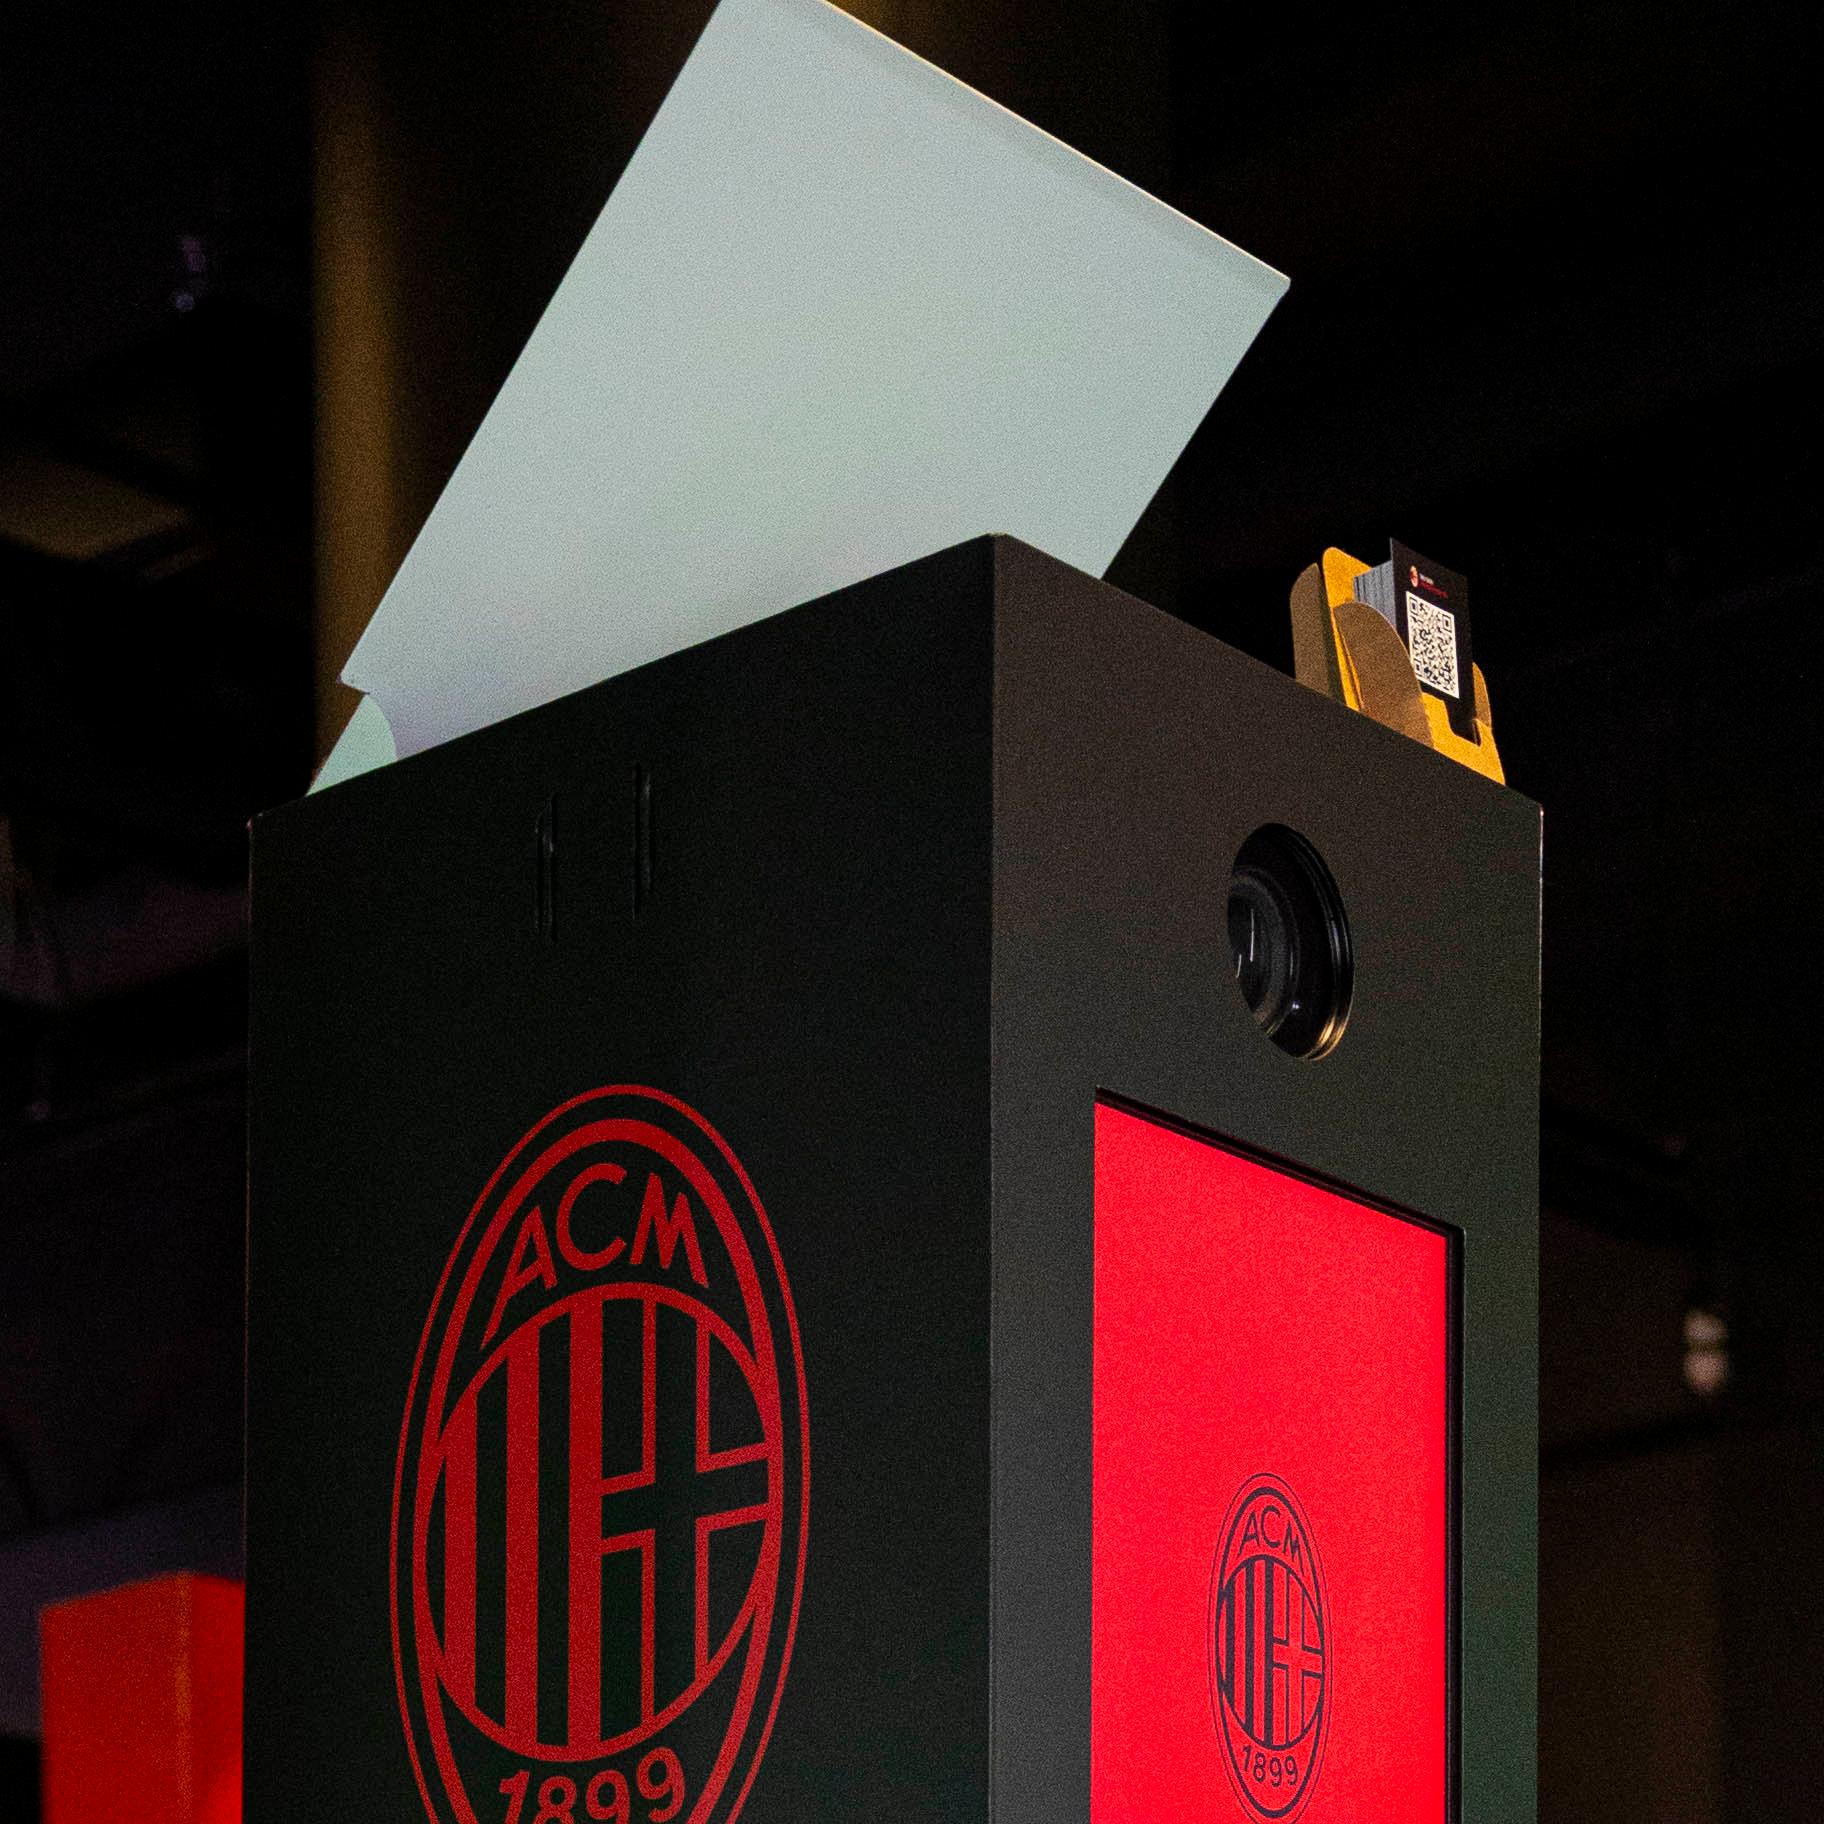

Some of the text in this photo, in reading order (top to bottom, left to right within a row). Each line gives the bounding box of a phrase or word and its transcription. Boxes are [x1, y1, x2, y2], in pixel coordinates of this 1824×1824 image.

[479, 1163, 709, 1352] ACM
[1237, 1505, 1304, 1576] ACM
[1242, 1744, 1298, 1788] 1899
